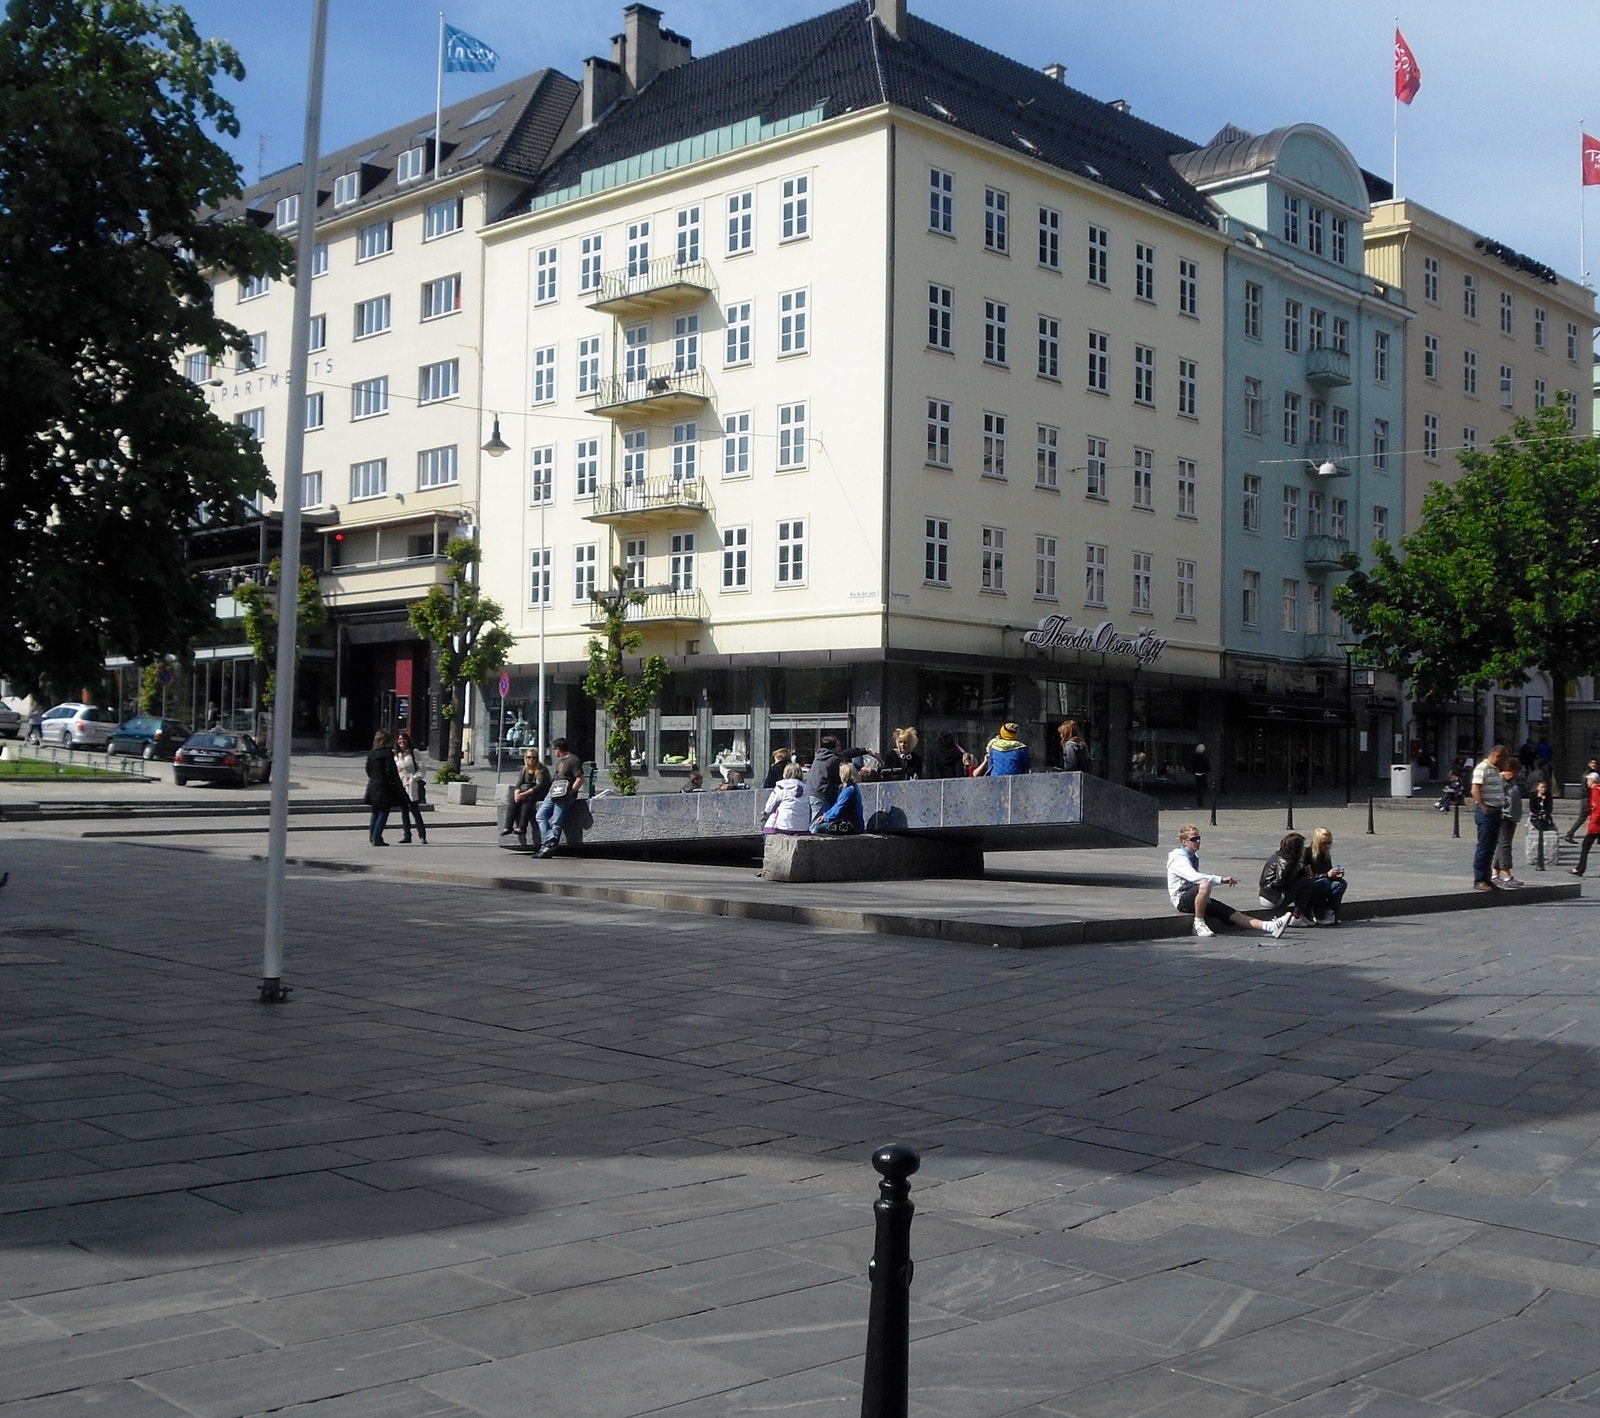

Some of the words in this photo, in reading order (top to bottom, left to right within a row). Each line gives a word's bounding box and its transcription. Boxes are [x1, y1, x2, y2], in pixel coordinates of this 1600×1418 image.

[209, 358, 334, 405] APARTMETS
[1040, 614, 1093, 652] Theodor
[1094, 621, 1138, 656] Olsens
